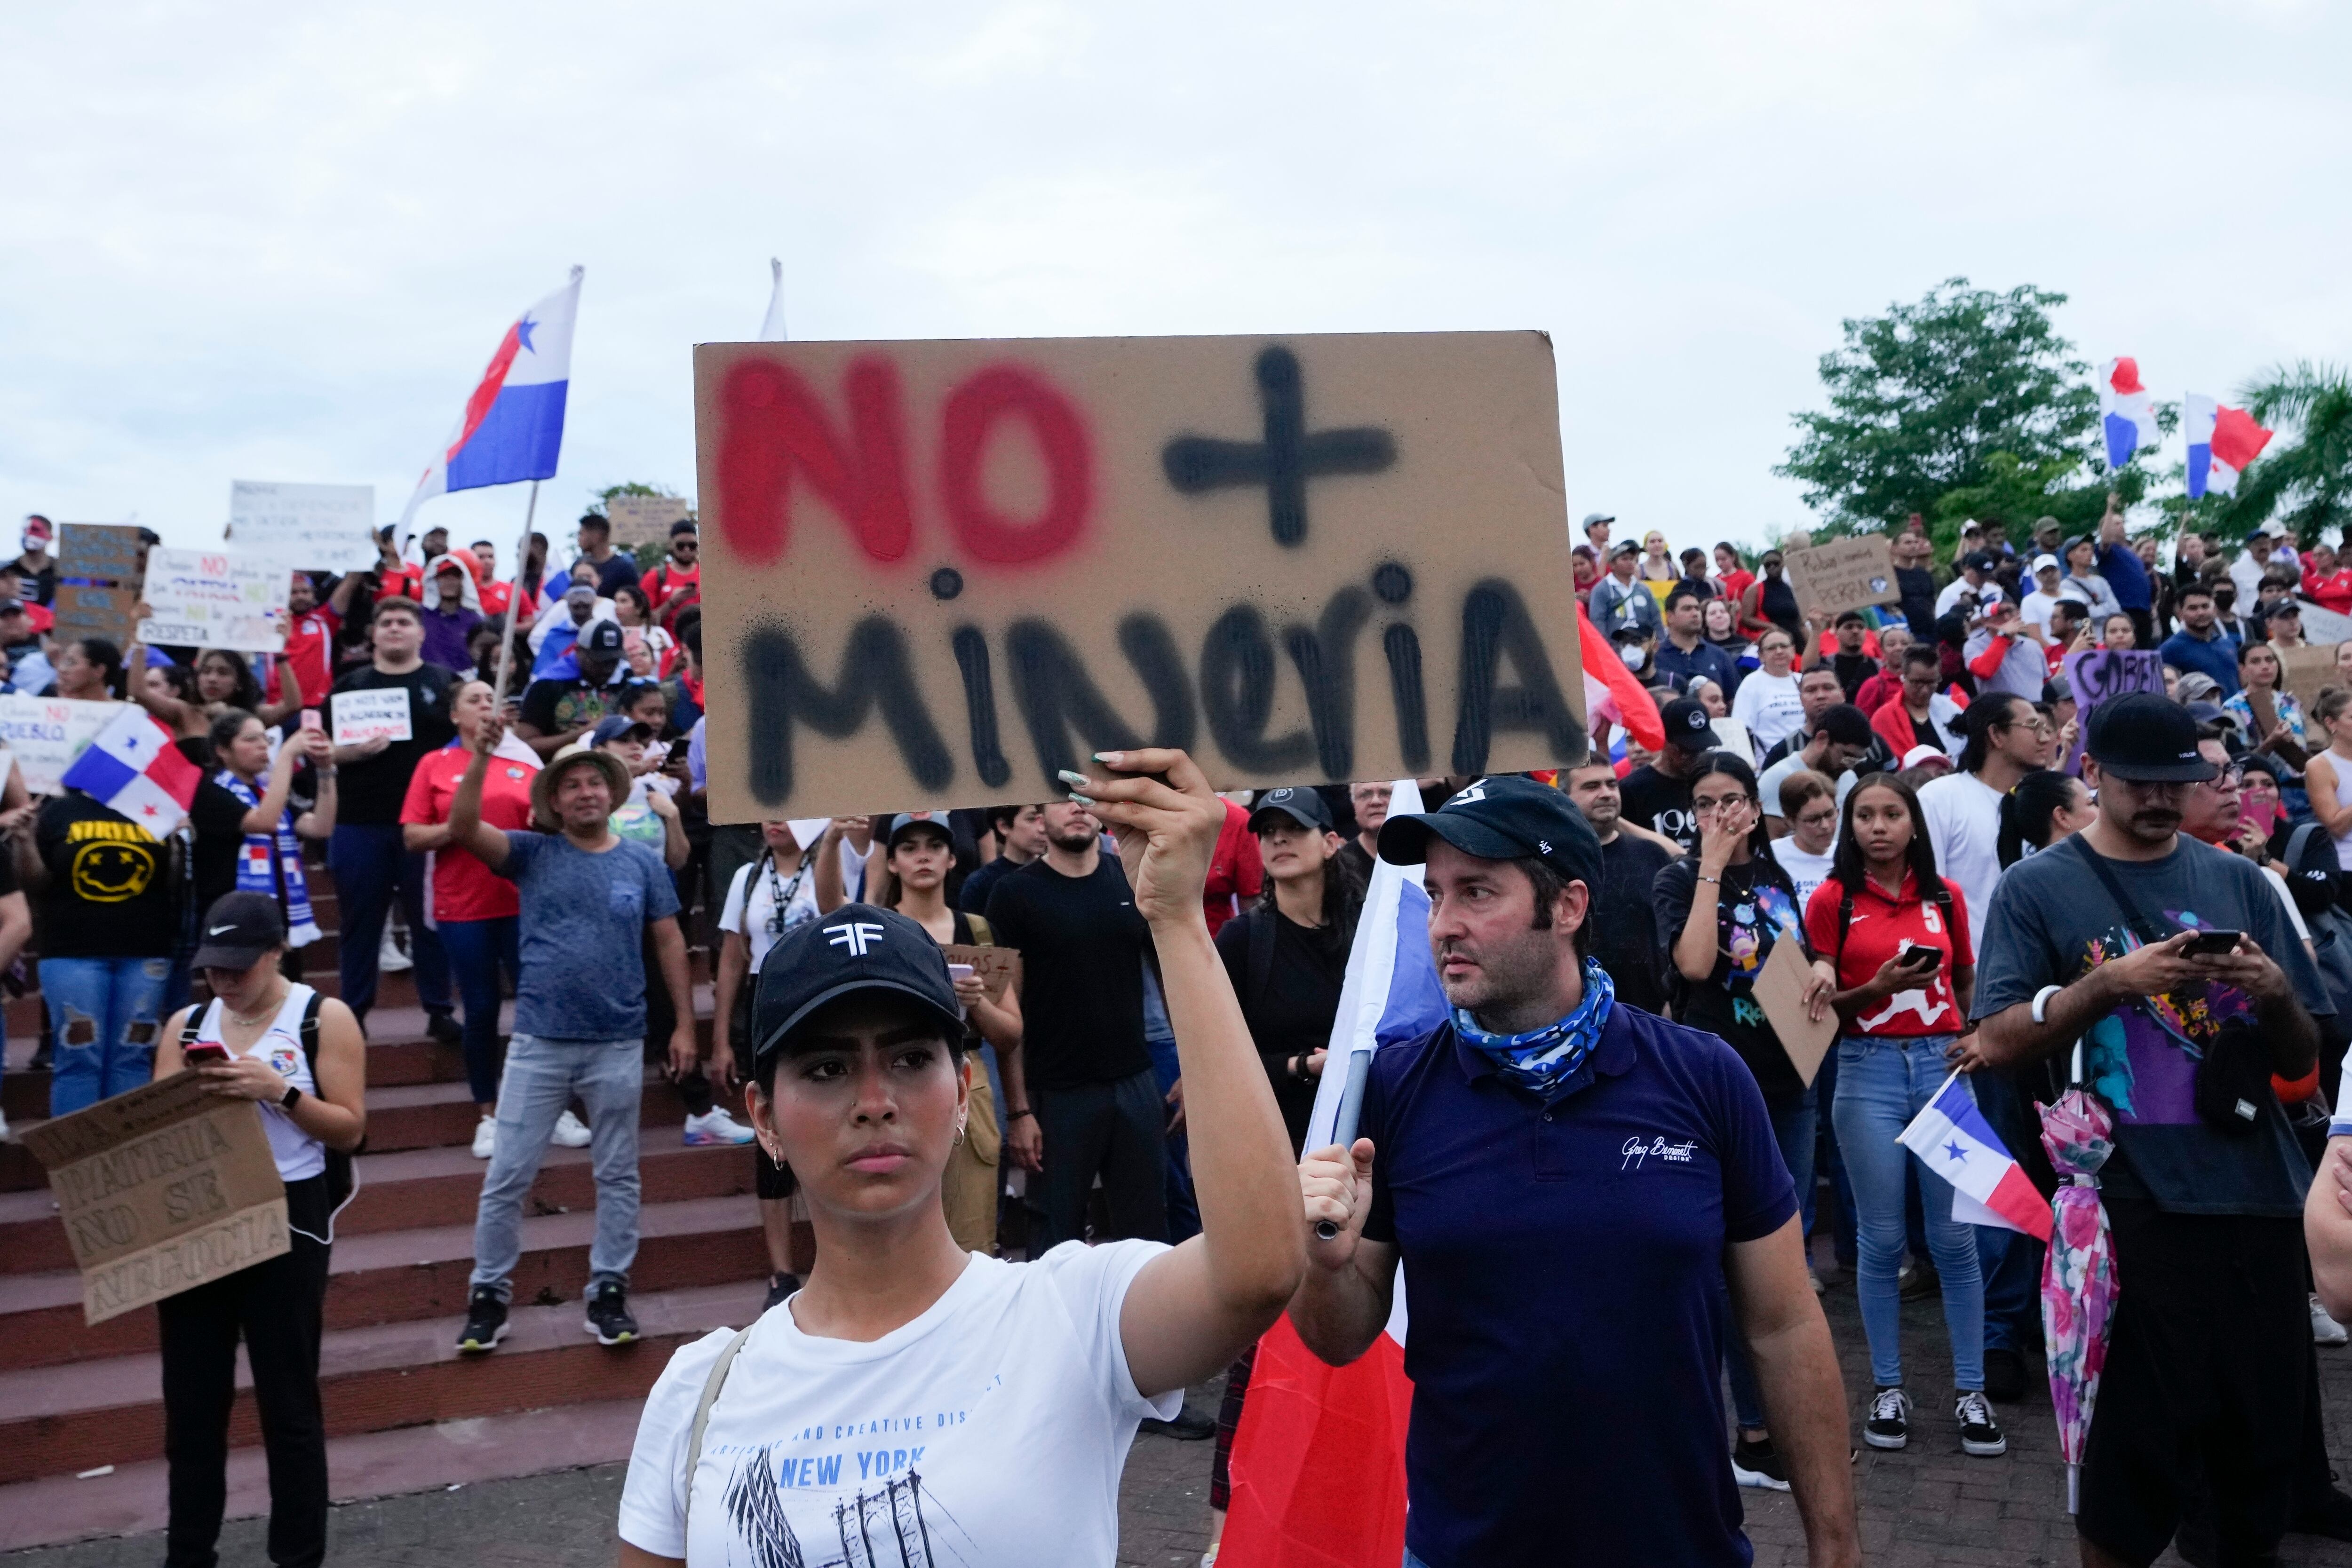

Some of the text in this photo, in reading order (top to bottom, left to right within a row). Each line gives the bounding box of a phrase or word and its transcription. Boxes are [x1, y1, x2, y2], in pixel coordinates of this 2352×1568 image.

[717, 350, 1097, 567] NO
[201, 556, 228, 576] NO
[65, 820, 166, 846] NIRVAN
[1921, 899, 1942, 934] 5
[1621, 1136, 1698, 1170] Greg Bennett
[72, 1169, 230, 1258] NO SE
[792, 1425, 823, 1442] AND
[835, 1416, 923, 1439] CREATIVE
[779, 1446, 926, 1489] NEW YORK
